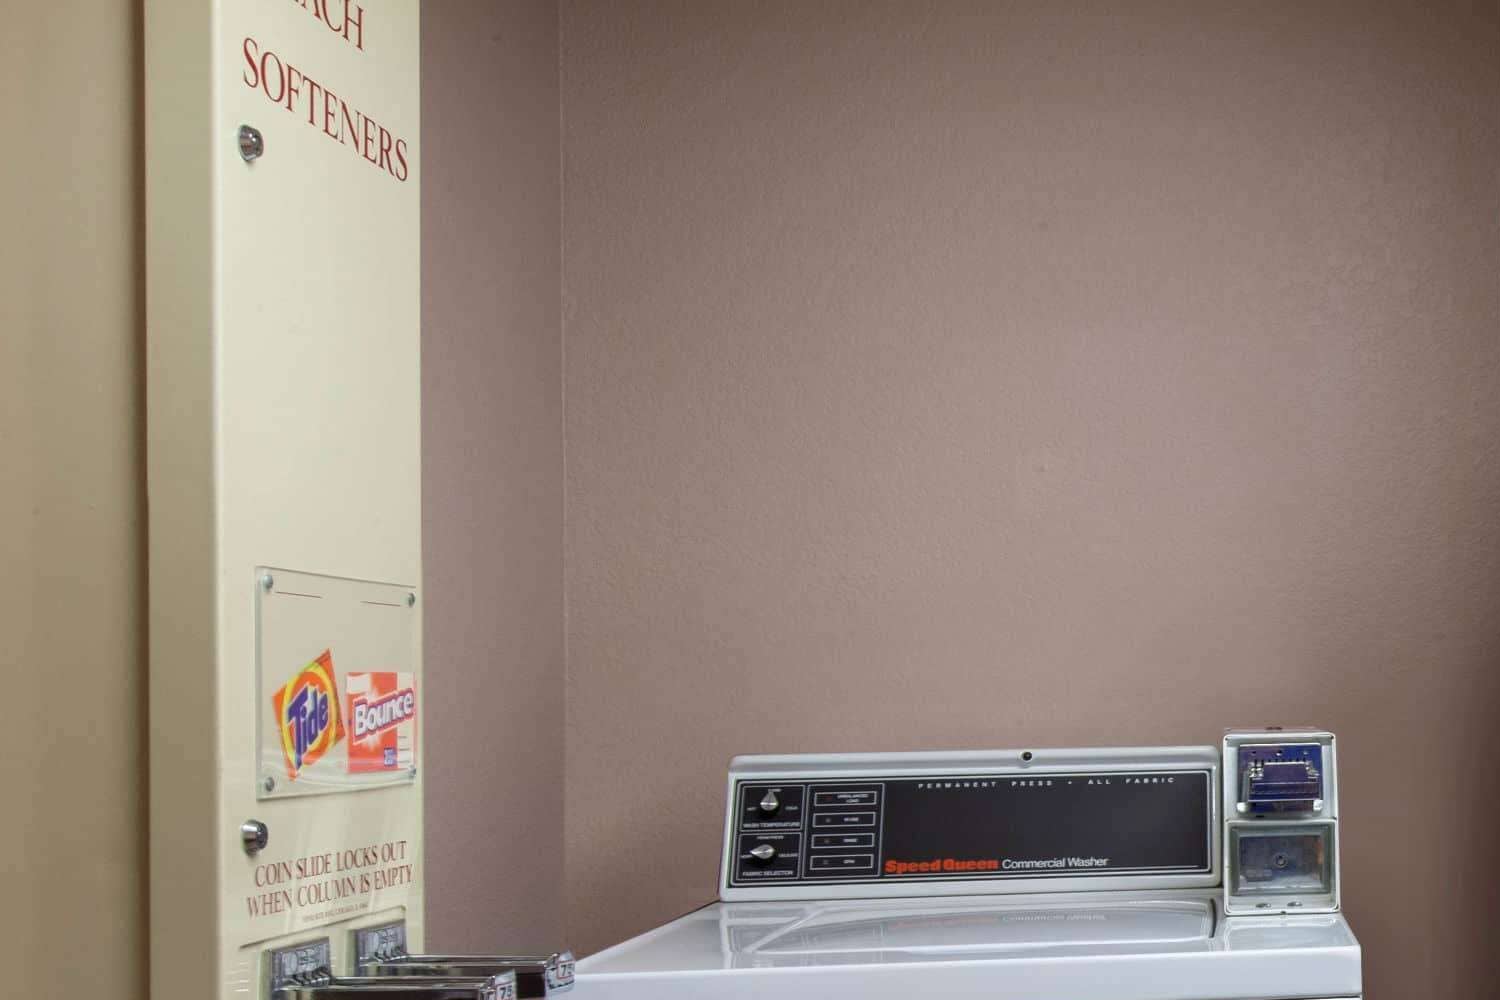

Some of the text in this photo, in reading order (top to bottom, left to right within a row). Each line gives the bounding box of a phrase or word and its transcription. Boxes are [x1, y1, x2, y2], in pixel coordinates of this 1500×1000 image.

[243, 37, 408, 182] SOFTENERS
[287, 686, 329, 770] Tide
[355, 692, 414, 736] Bounce
[918, 781, 998, 789] PERMANENT
[255, 840, 407, 887] COIN SLIDE LOCKS OUT
[884, 857, 1108, 875] Speed Queen Commercial Washer
[247, 888, 293, 917] WHEN
[298, 876, 356, 907] COLUMN
[360, 873, 370, 893] IS
[374, 864, 413, 890] EMPTY
